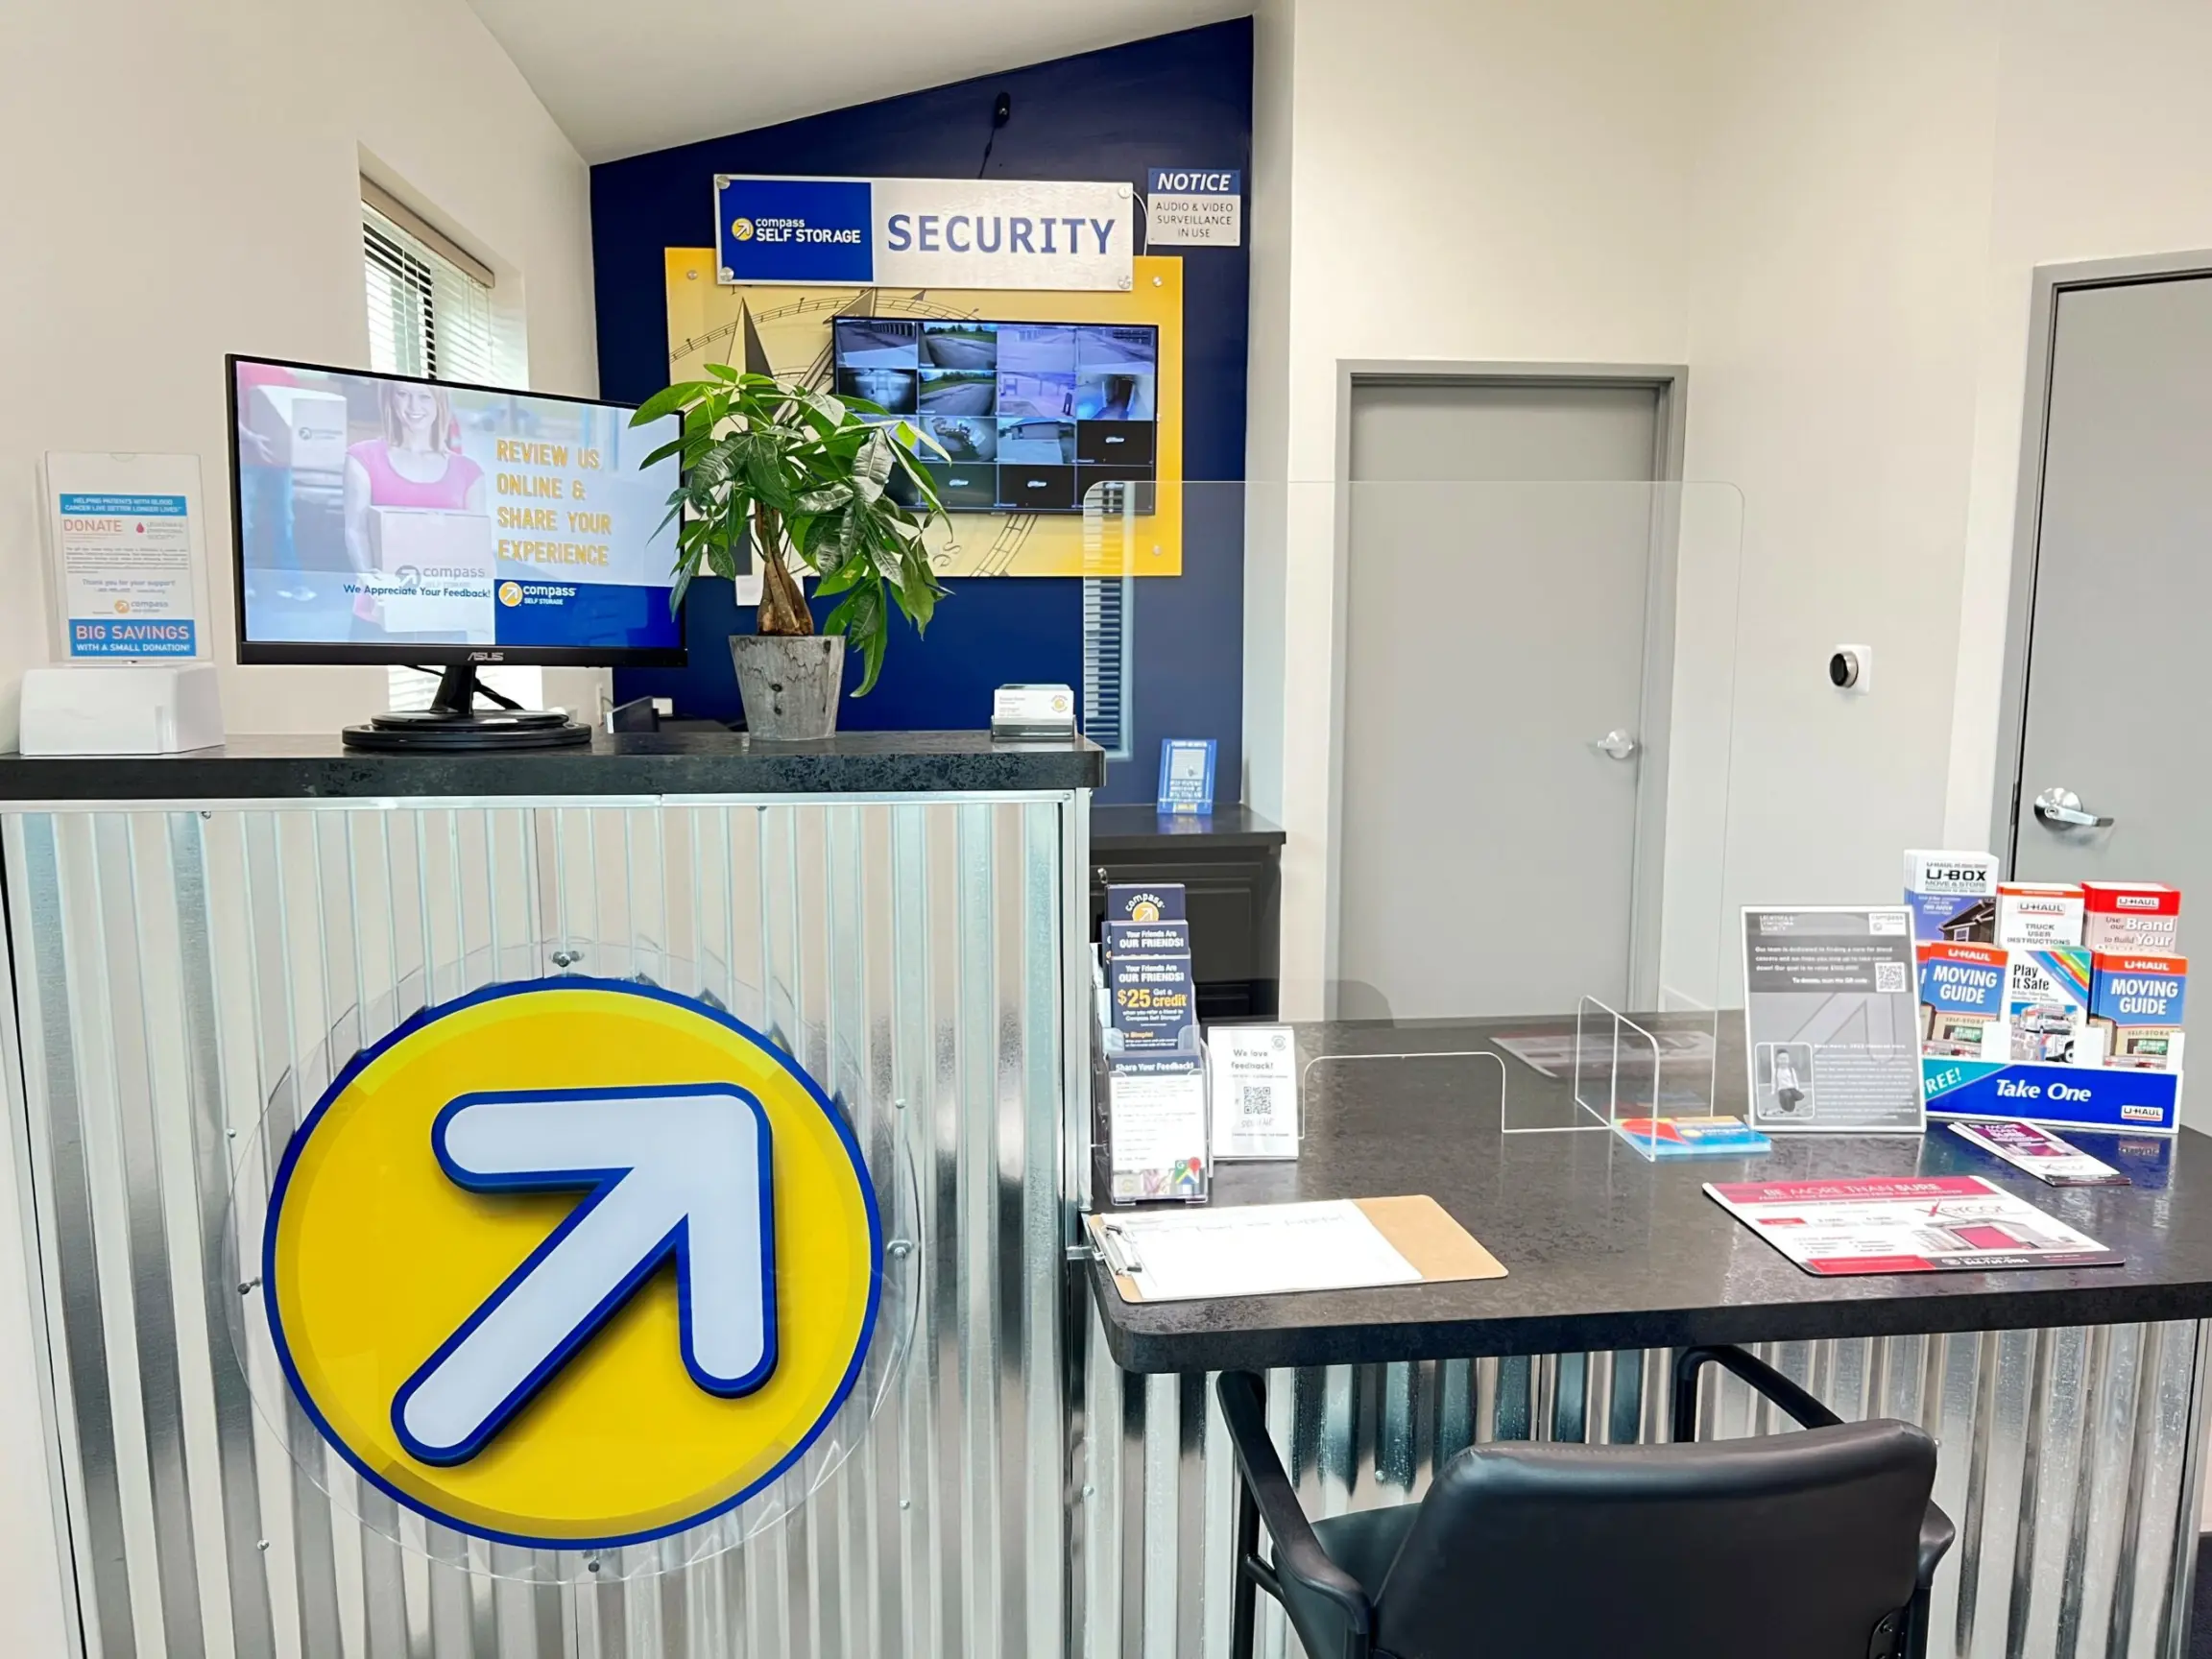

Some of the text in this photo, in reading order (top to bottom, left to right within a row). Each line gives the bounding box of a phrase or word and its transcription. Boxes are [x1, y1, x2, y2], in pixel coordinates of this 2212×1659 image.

[1156, 172, 1233, 192] NOTICE
[1156, 203, 1234, 212] AUDIO & VIDEO
[756, 217, 805, 231] compass
[1157, 215, 1232, 226] SURVEILLANCE
[757, 228, 862, 245] SELF STORAGE
[886, 213, 1117, 255] SECURITY
[1178, 228, 1211, 238] IN USE
[496, 440, 600, 469] REVIEW US
[496, 473, 587, 500] ONLINE &
[63, 518, 123, 532] DONATE
[497, 506, 612, 535] SHARE YOUR
[498, 539, 610, 566] EXPERIENCE
[423, 565, 485, 581] compass
[343, 584, 491, 598] We Appreciate Your Feedback!
[523, 586, 576, 598] compass
[76, 625, 189, 640] BIG SAVINGS
[77, 643, 99, 652] WITH
[143, 643, 190, 652] DONATION!
[468, 652, 504, 661] ASUS
[1926, 869, 1986, 881] U-BOX
[1125, 893, 1164, 912] compass
[2019, 902, 2063, 912] U-HAUL
[2118, 898, 2158, 906] U-HAUL
[2125, 918, 2175, 932] Brand
[1126, 930, 1141, 939] Your
[2007, 937, 2071, 946] INSTRUCTIONS
[2114, 935, 2134, 944] Build
[2134, 933, 2173, 947] Your
[1119, 938, 1185, 949] OUR FRIENDS!
[1948, 949, 1991, 961] U-HAUL
[1125, 964, 1141, 973] Your
[1141, 964, 1165, 973] Friends
[2013, 964, 2038, 978] Play
[2124, 960, 2170, 971] U-HAUL
[1118, 972, 1185, 983] OUR FRIENDS!
[1933, 965, 1997, 988] MOVING
[2012, 977, 2050, 991] It Safe
[2110, 978, 2179, 998] MOVING
[1118, 989, 1151, 1008] $25
[1939, 983, 1985, 1004] GUIDE
[2119, 997, 2168, 1016] GUIDE
[1116, 1061, 1194, 1071] Share Your Feedback!
[1924, 1066, 1962, 1094] REE!
[1997, 1078, 2092, 1103] Take One
[2123, 1106, 2161, 1118] U-HAUL
[1895, 1183, 1942, 1192] SURE
